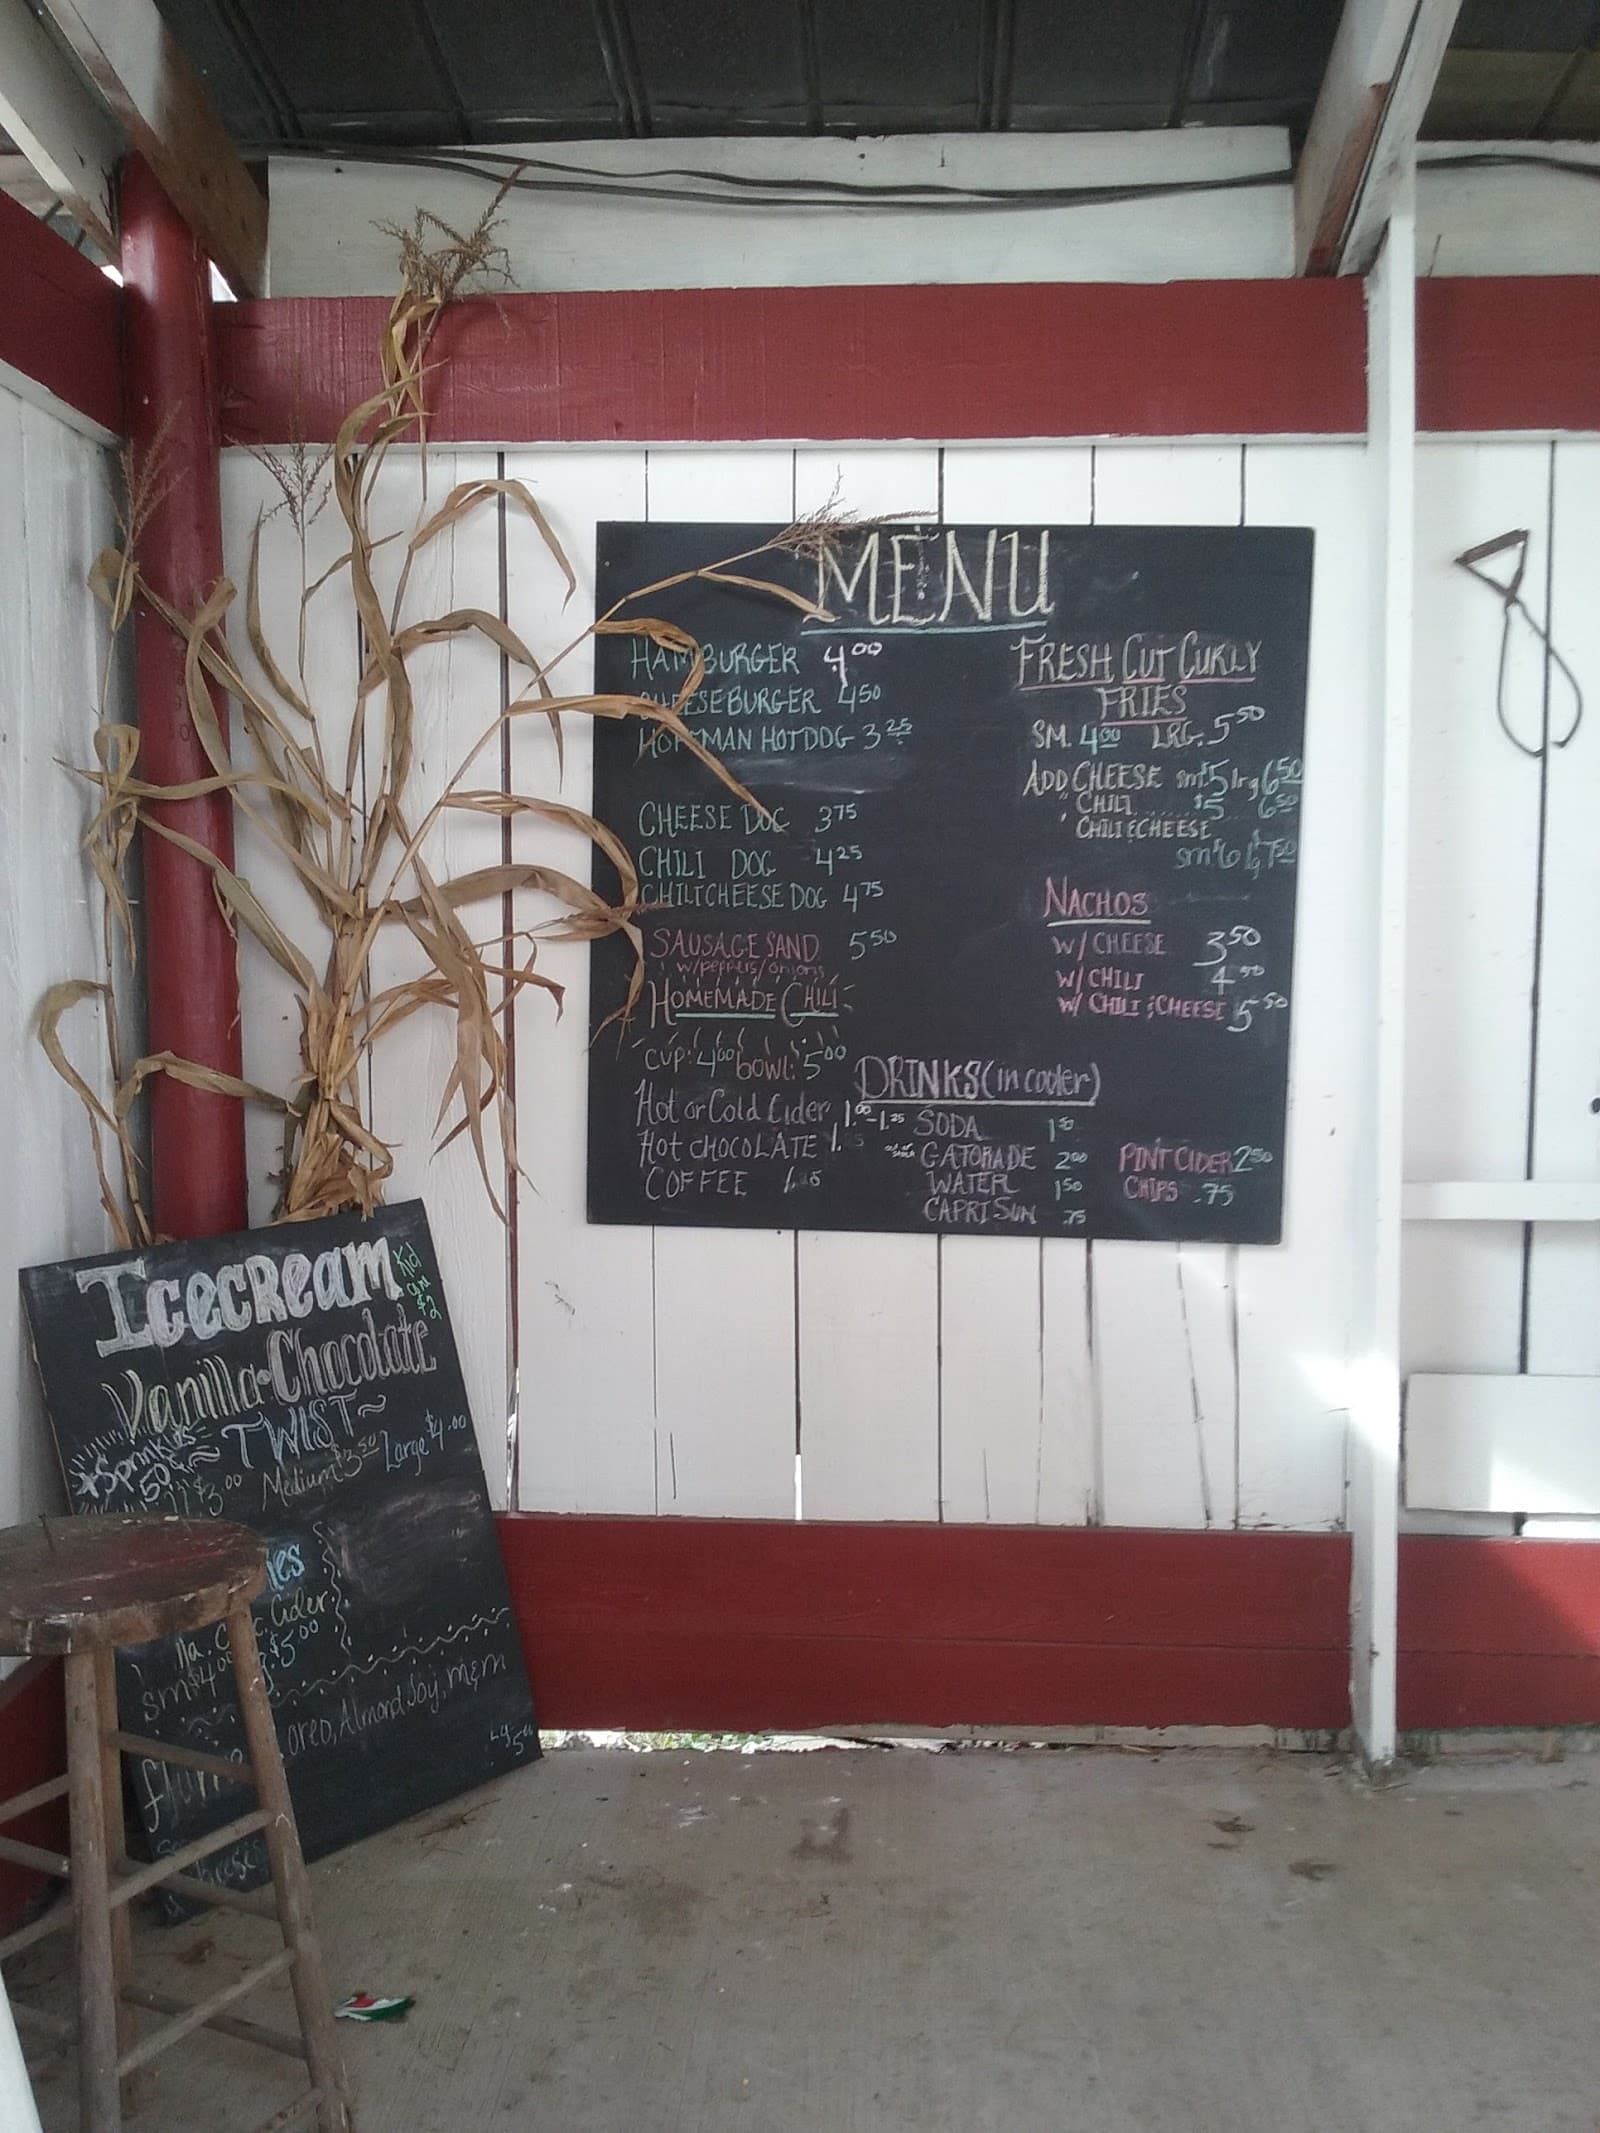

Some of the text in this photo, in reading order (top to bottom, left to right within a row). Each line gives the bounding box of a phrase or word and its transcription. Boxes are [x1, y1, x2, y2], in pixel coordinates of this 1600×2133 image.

[803, 529, 1055, 626] MENU
[631, 637, 801, 681] HAMBURGER
[1010, 633, 1115, 685] FRESH
[1178, 630, 1262, 680] CURLY
[1094, 683, 1188, 720] FRIES
[1022, 759, 1069, 797] ADD
[1071, 760, 1164, 793] CHEESE
[638, 801, 733, 838] CHEESE
[1075, 792, 1133, 816] CHILI
[638, 845, 706, 880] CHILI
[730, 848, 777, 881] DOG
[790, 883, 828, 910] DOG
[1043, 875, 1149, 919] NACHOS
[650, 927, 760, 959] SAUSAGE
[766, 930, 821, 963] SAND
[1092, 930, 1168, 956] CHEESE
[1088, 965, 1144, 991] CHILI
[648, 977, 839, 1030] HOMEMADE CHILI
[854, 1055, 981, 1100] DRINKS
[634, 1077, 680, 1127] Hot
[684, 1098, 707, 1121] or
[708, 1088, 760, 1124] Cold
[767, 1090, 831, 1126] Cider
[912, 1107, 987, 1141] SODA
[636, 1127, 684, 1168] Hot
[920, 1140, 1036, 1170] GATORADE
[1119, 1140, 1173, 1173] PINT
[1173, 1145, 1233, 1175] CIDER
[645, 1165, 749, 1201] COFFEE
[926, 1170, 1020, 1196] WATER
[1123, 1174, 1179, 1203] CHIPS
[923, 1195, 991, 1225] CAPRI
[993, 1196, 1037, 1225] SUN
[392, 1240, 423, 1279] Kid
[102, 1303, 437, 1445] Vanilla Chocolate
[221, 1390, 358, 1471] TWIST
[262, 1463, 345, 1512] Medium
[379, 1429, 430, 1477] Large
[270, 1586, 329, 1628] Cider
[339, 1684, 405, 1736] Almond
